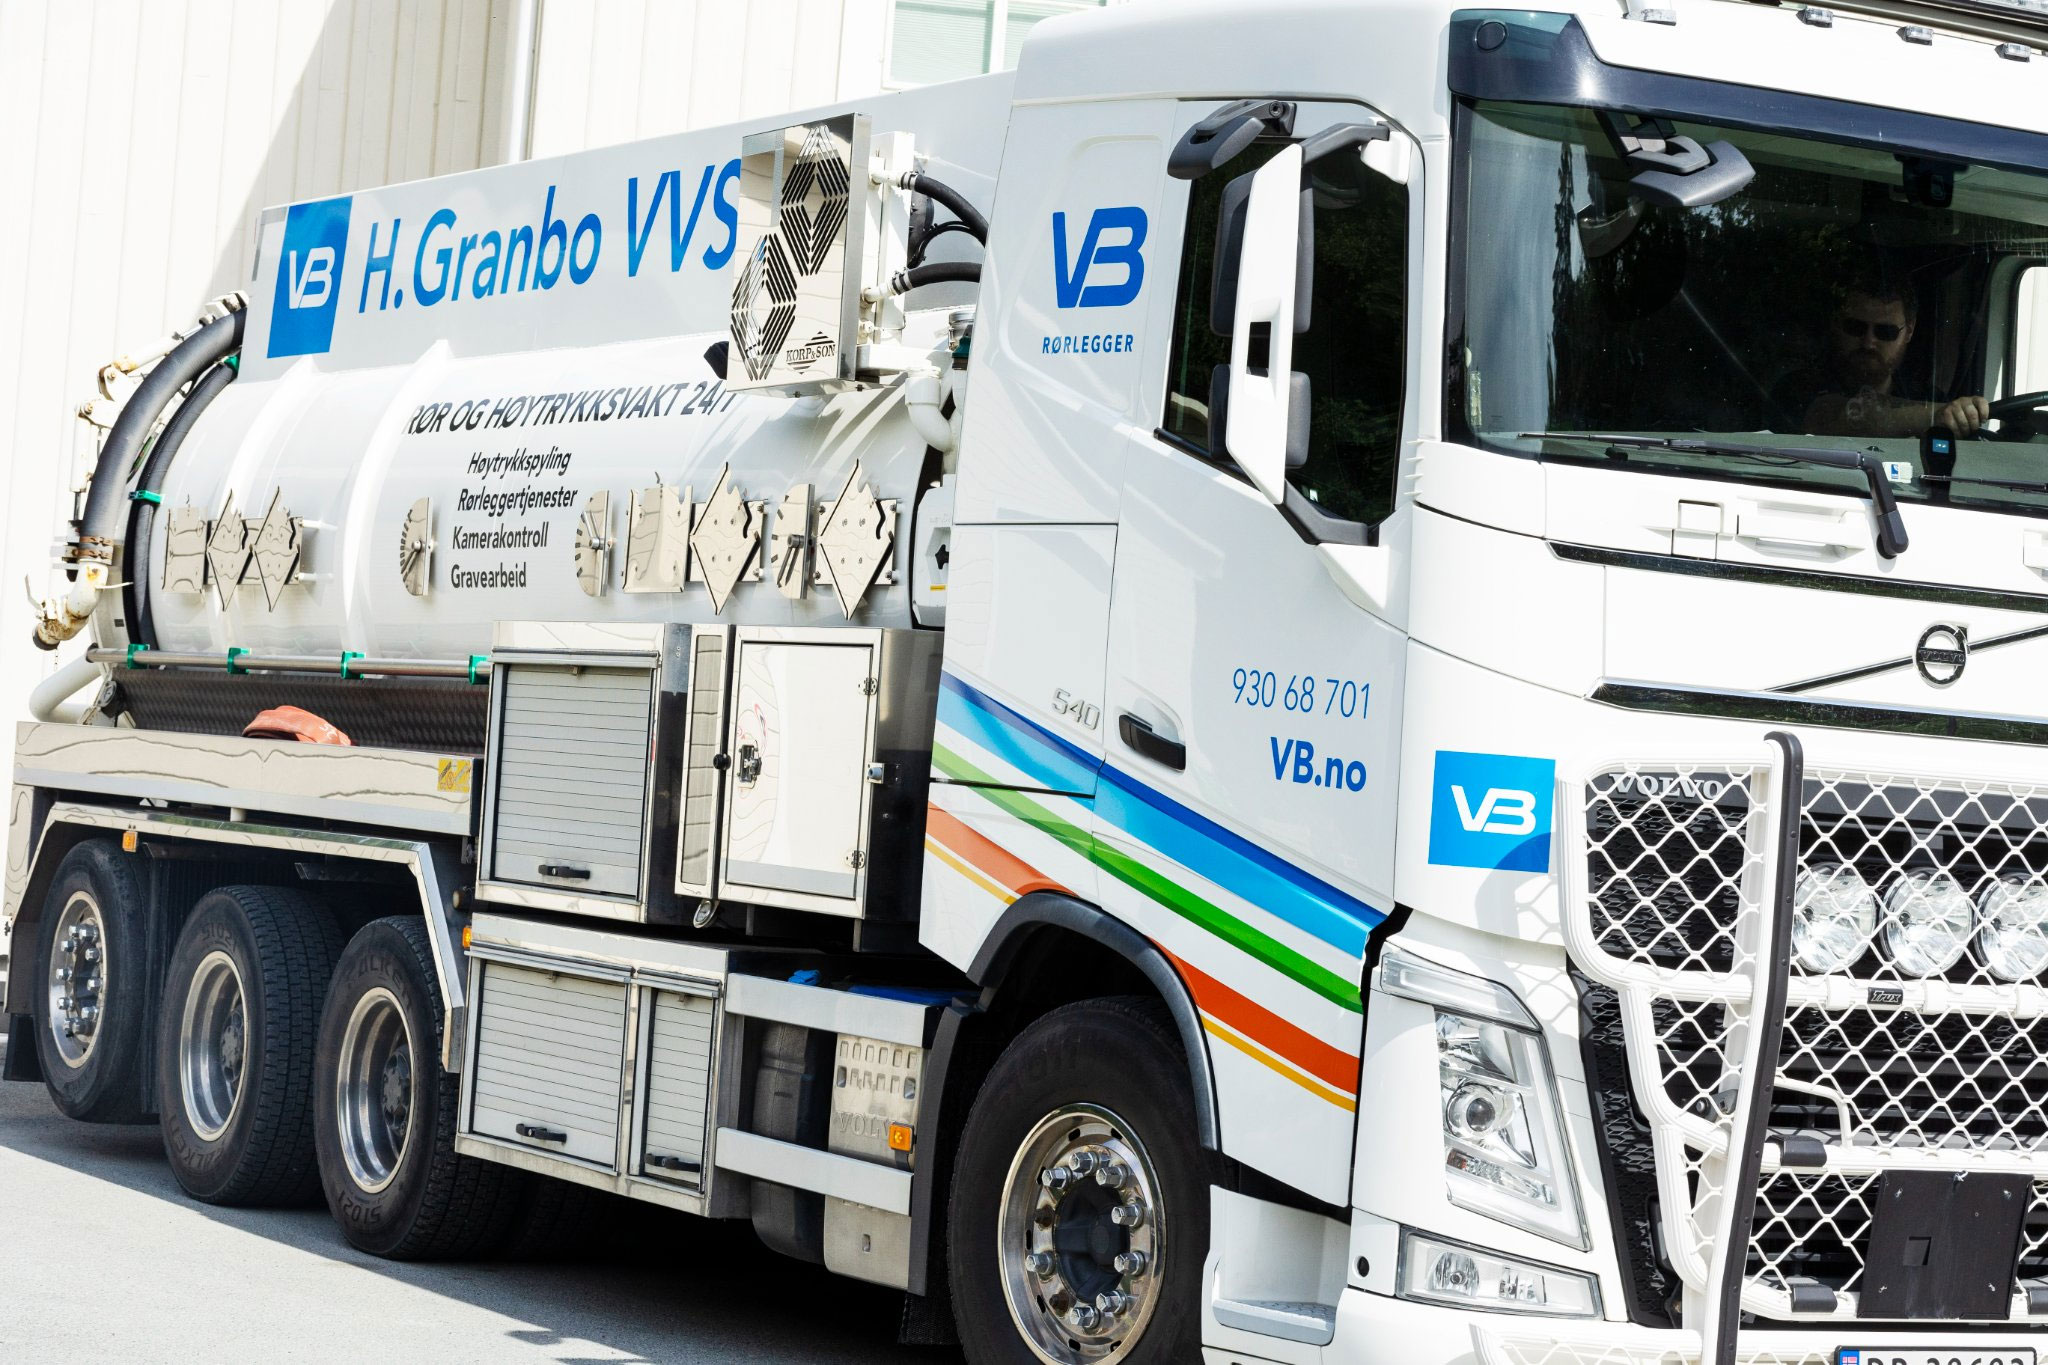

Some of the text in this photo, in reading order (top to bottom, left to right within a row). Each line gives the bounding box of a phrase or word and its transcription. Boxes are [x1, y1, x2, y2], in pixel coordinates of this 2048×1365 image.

[628, 158, 742, 277] VVS
[1053, 206, 1148, 308] VB
[289, 246, 335, 309] VB
[786, 344, 836, 362] KORP&SON
[1042, 334, 1134, 354] RØRLEGGER
[402, 402, 453, 435] RØR
[449, 399, 491, 431] OG
[484, 382, 690, 429] HØYTRYKKSVAKT
[467, 446, 572, 480] Høytrykkspyling
[457, 485, 578, 517] Rørleggertjenester
[452, 521, 549, 549] Kamerakontroll
[451, 562, 527, 588] Gravearbeid
[1052, 688, 1100, 730] 540
[1233, 668, 1370, 719] 930 68 701
[1271, 736, 1367, 792] VB.no
[1609, 773, 1724, 800] VOLVO
[1451, 784, 1536, 835] VB
[1870, 990, 1902, 1003] Trux
[836, 1111, 890, 1138] VOLV
